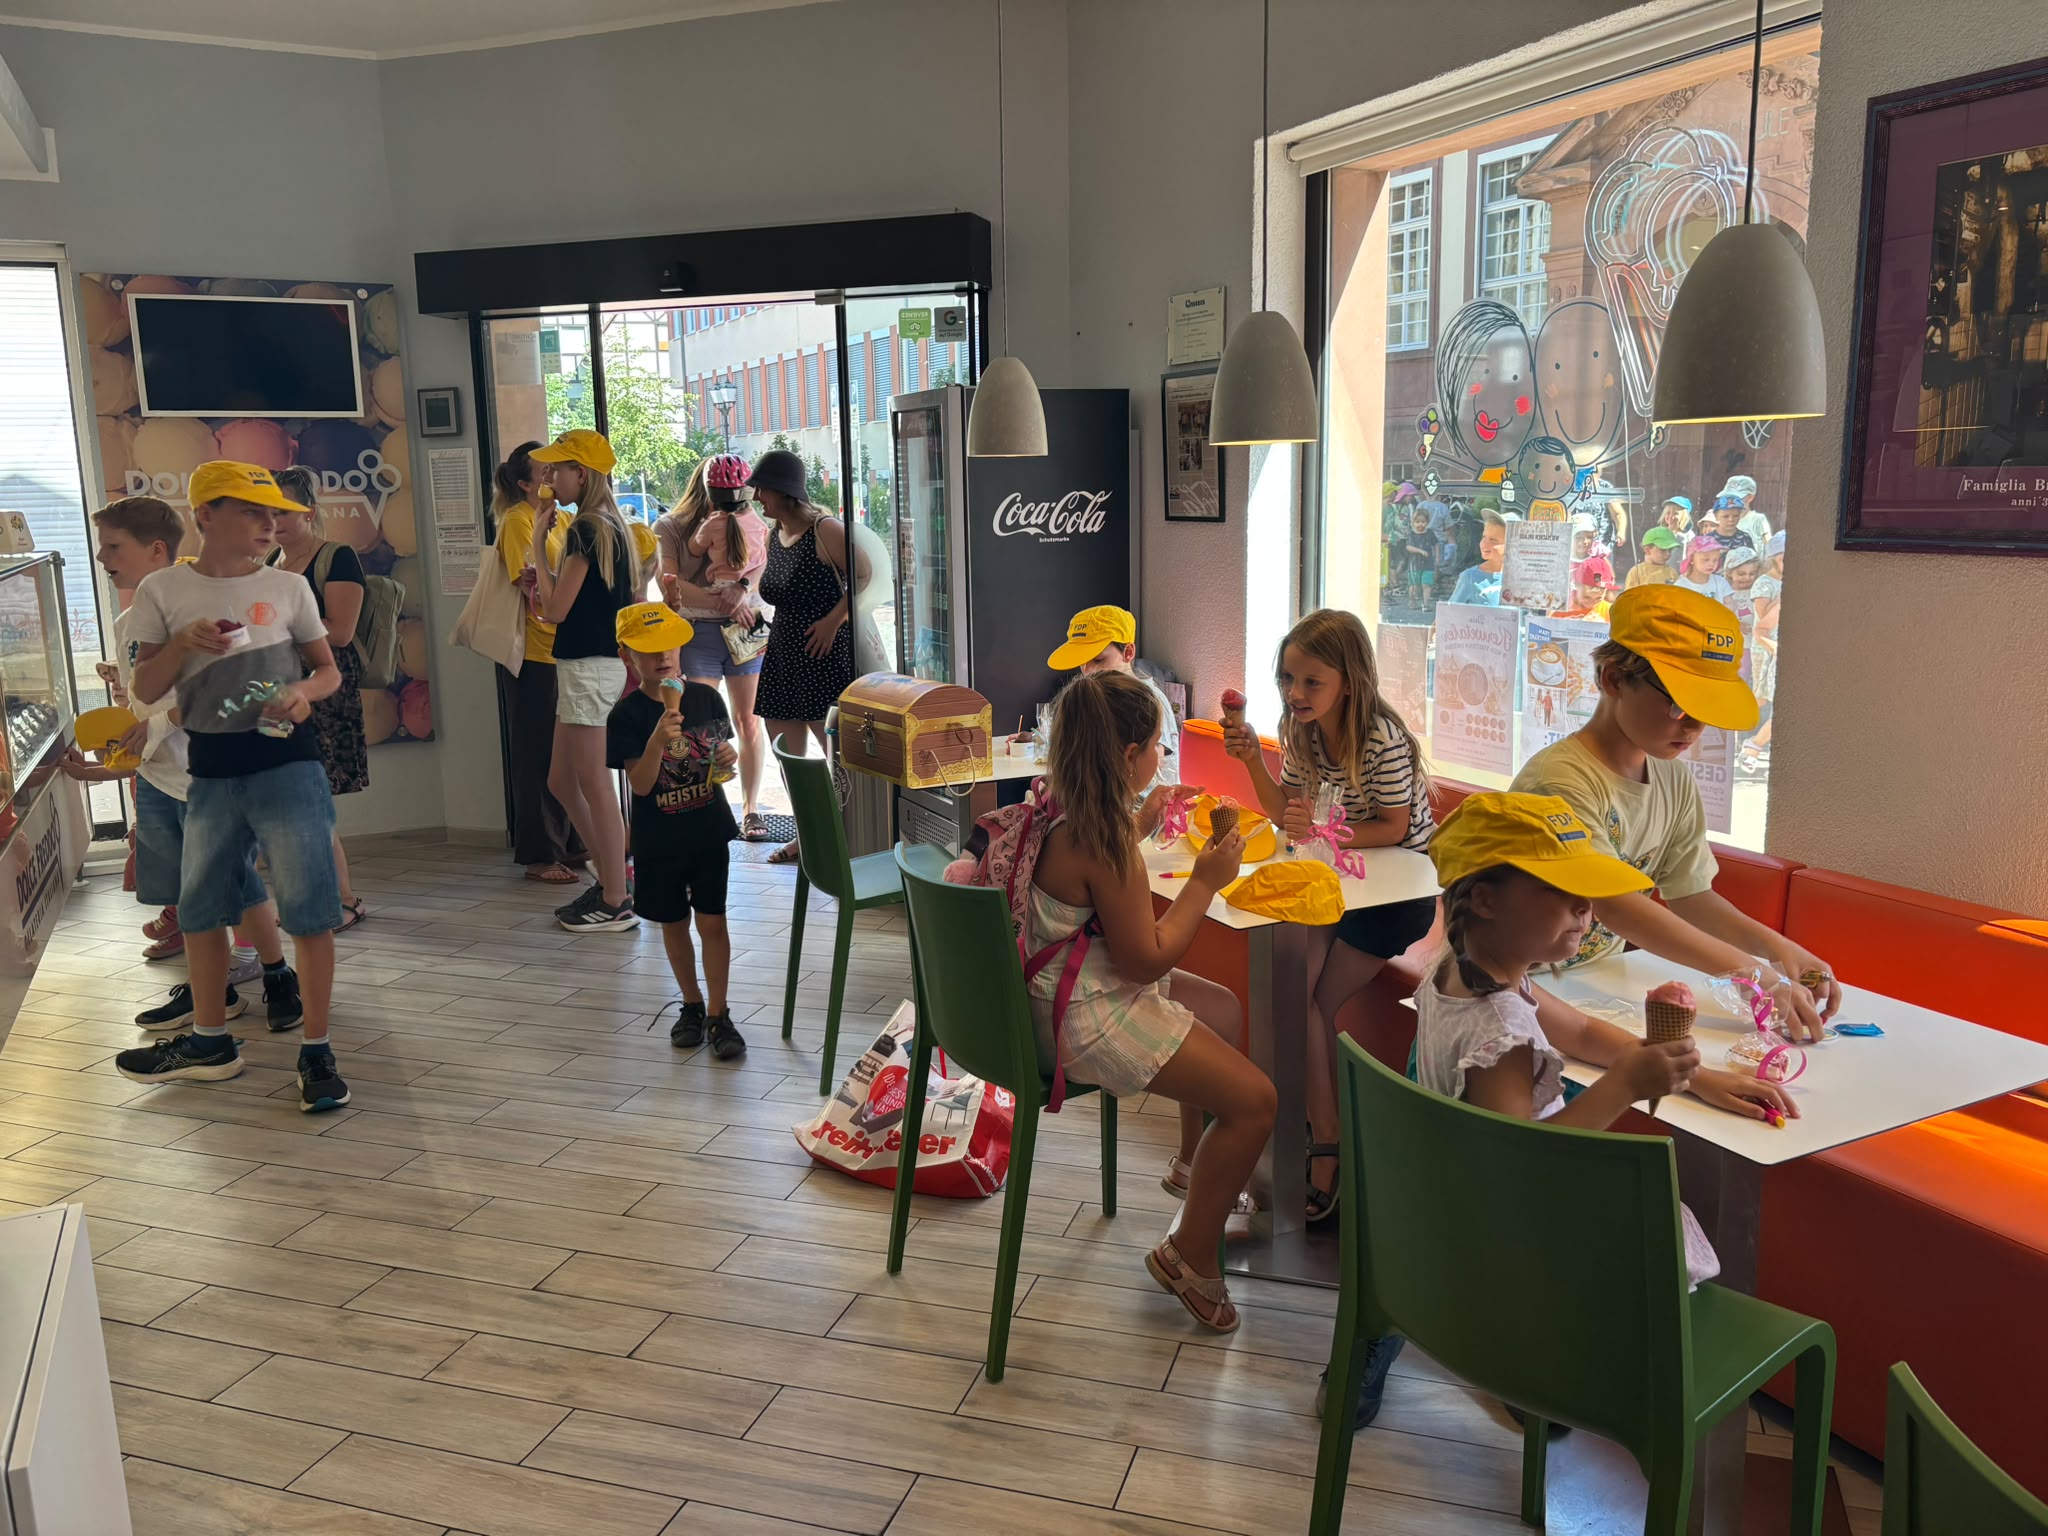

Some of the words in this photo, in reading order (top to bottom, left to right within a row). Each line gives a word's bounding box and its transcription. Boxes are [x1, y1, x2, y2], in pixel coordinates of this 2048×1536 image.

[1963, 479, 2027, 493] Famiglia
[993, 491, 1113, 536] Coca-Cola
[1707, 632, 1734, 648] FDP
[1546, 812, 1572, 827] FDP
